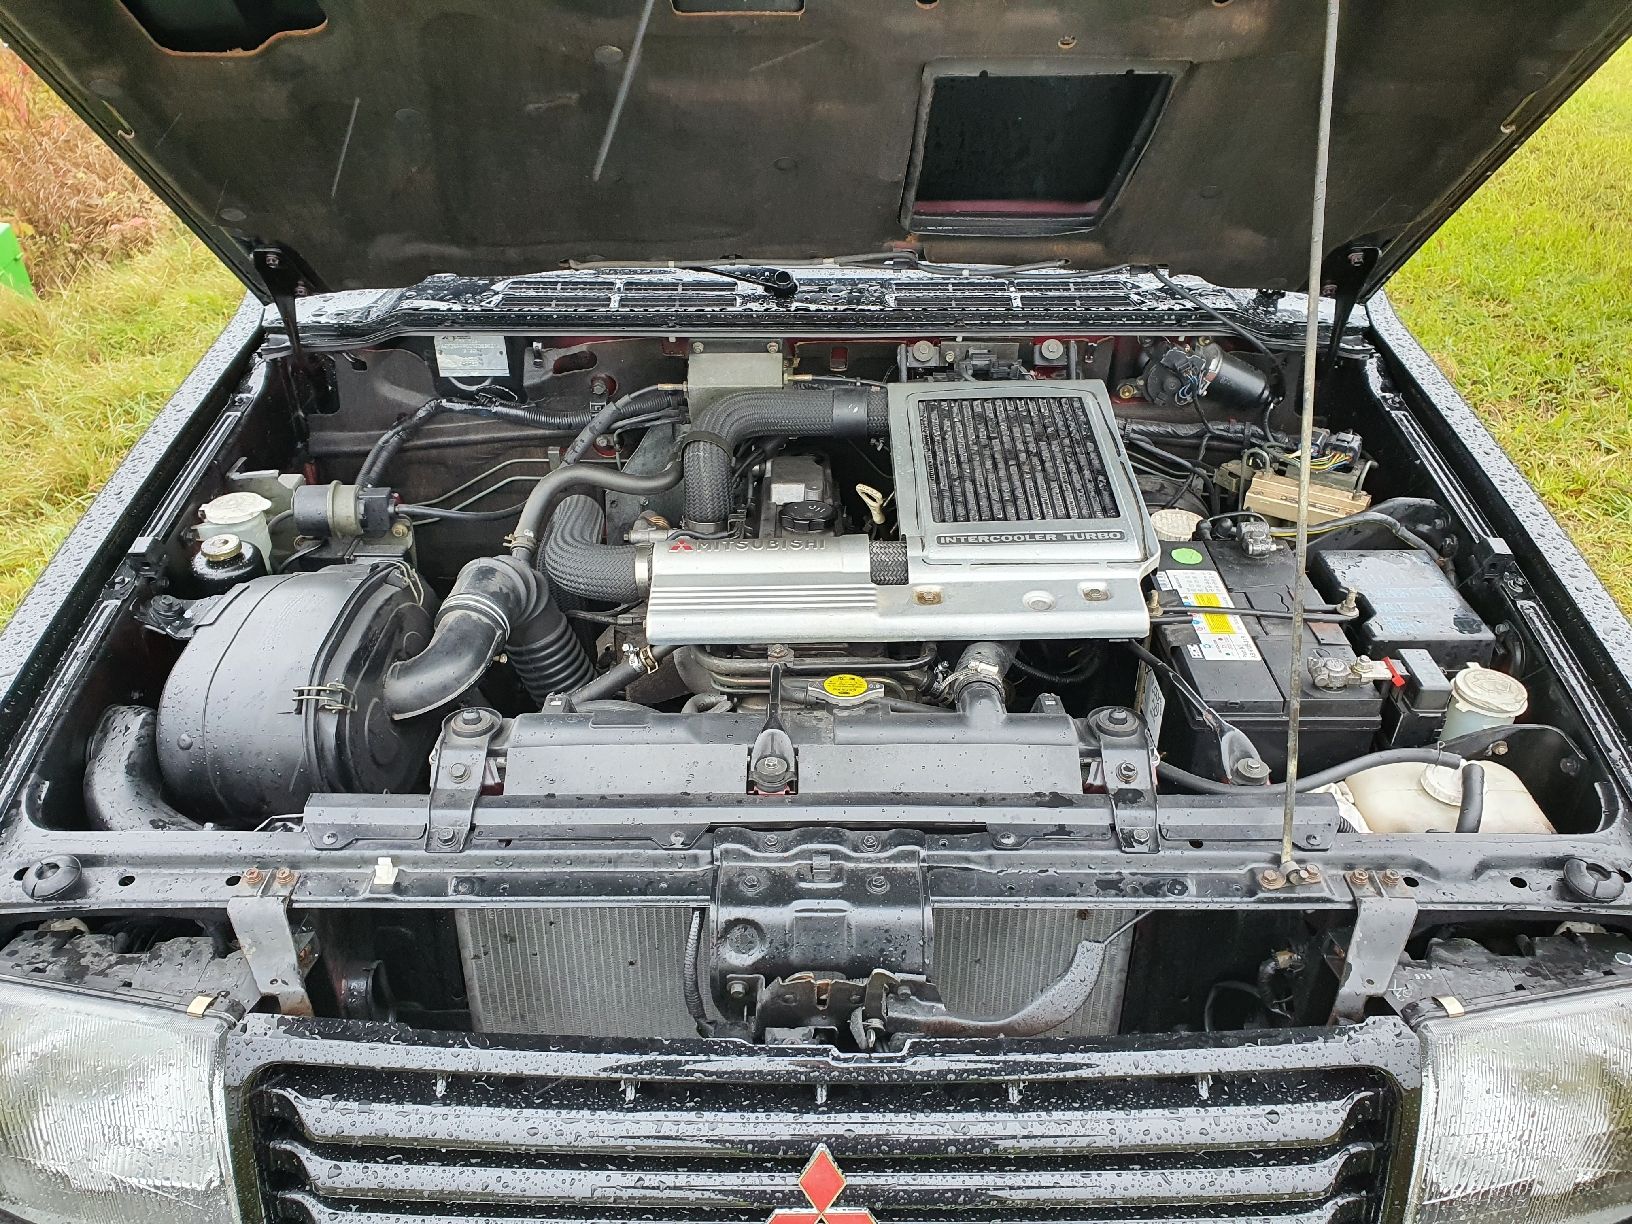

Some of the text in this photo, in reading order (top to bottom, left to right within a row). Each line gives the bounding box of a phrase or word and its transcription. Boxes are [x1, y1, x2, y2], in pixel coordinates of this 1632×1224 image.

[940, 531, 1122, 544] INTERCOOLER TURBO
[695, 539, 827, 552] MITSUBISHI
